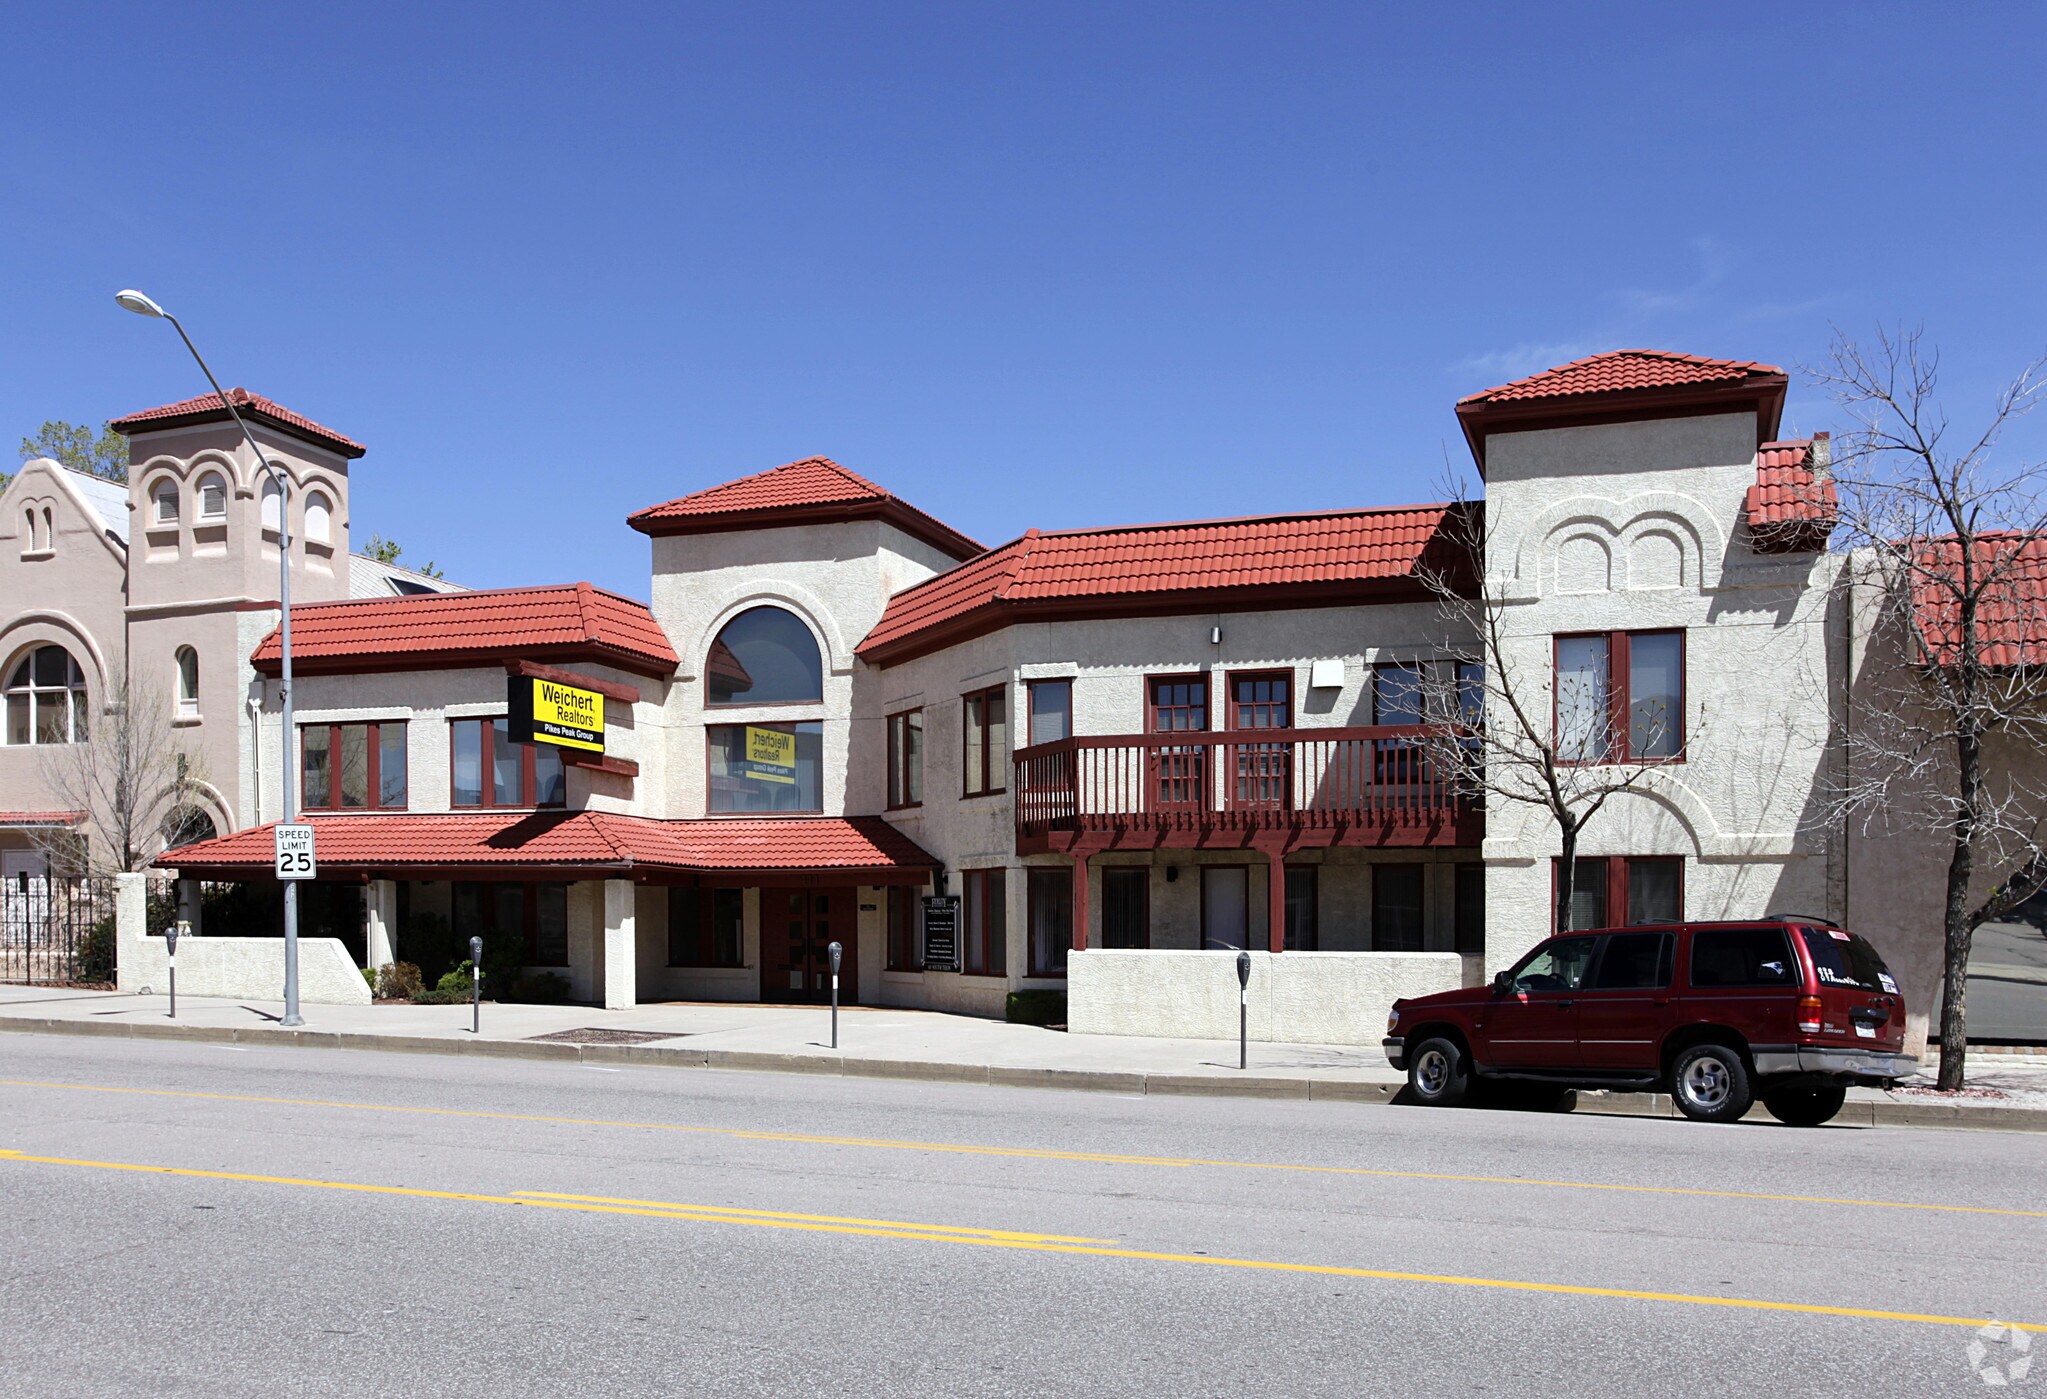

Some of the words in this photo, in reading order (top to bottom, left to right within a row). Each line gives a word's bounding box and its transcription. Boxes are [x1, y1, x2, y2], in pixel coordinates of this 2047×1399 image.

[544, 723, 561, 735] Pikes
[561, 727, 576, 738] Peak
[576, 730, 594, 742] Group
[278, 830, 311, 839] SPEED
[282, 842, 307, 850] LIMIT
[280, 852, 311, 872] 25
